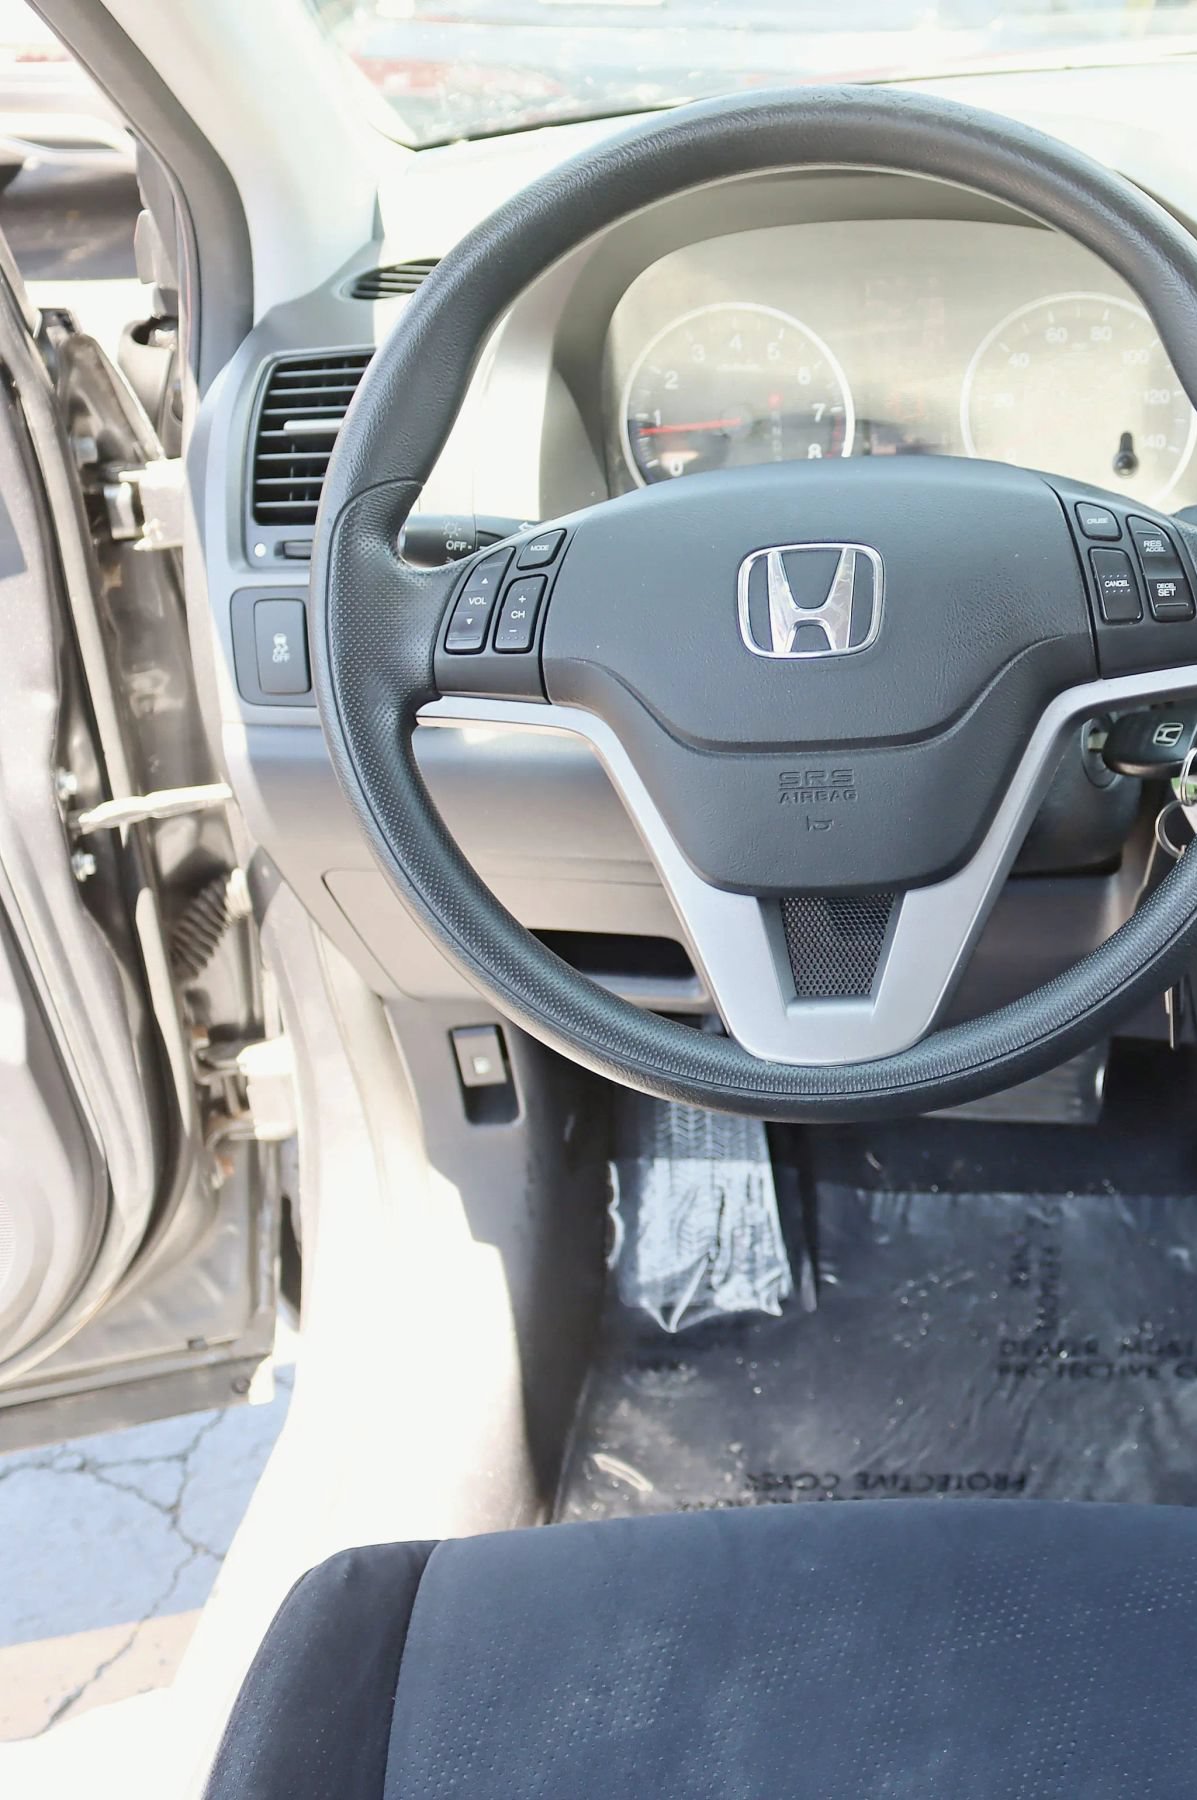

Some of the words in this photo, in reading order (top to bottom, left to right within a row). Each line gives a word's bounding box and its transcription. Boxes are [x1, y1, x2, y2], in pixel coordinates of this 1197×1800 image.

[730, 335, 742, 350] 4
[1008, 352, 1030, 369] 40
[664, 371, 678, 389] 2
[653, 410, 662, 426] 1
[812, 403, 826, 422] 7
[670, 460, 683, 477] 0
[446, 541, 467, 552] OFF
[1143, 540, 1162, 548] RES
[1104, 580, 1130, 588] CANCEL
[1157, 588, 1176, 597] SET
[468, 597, 487, 606] VOL
[511, 610, 526, 619] CH
[272, 653, 290, 664] OFF
[779, 768, 856, 787] SRS
[779, 789, 859, 806] AIRBAG
